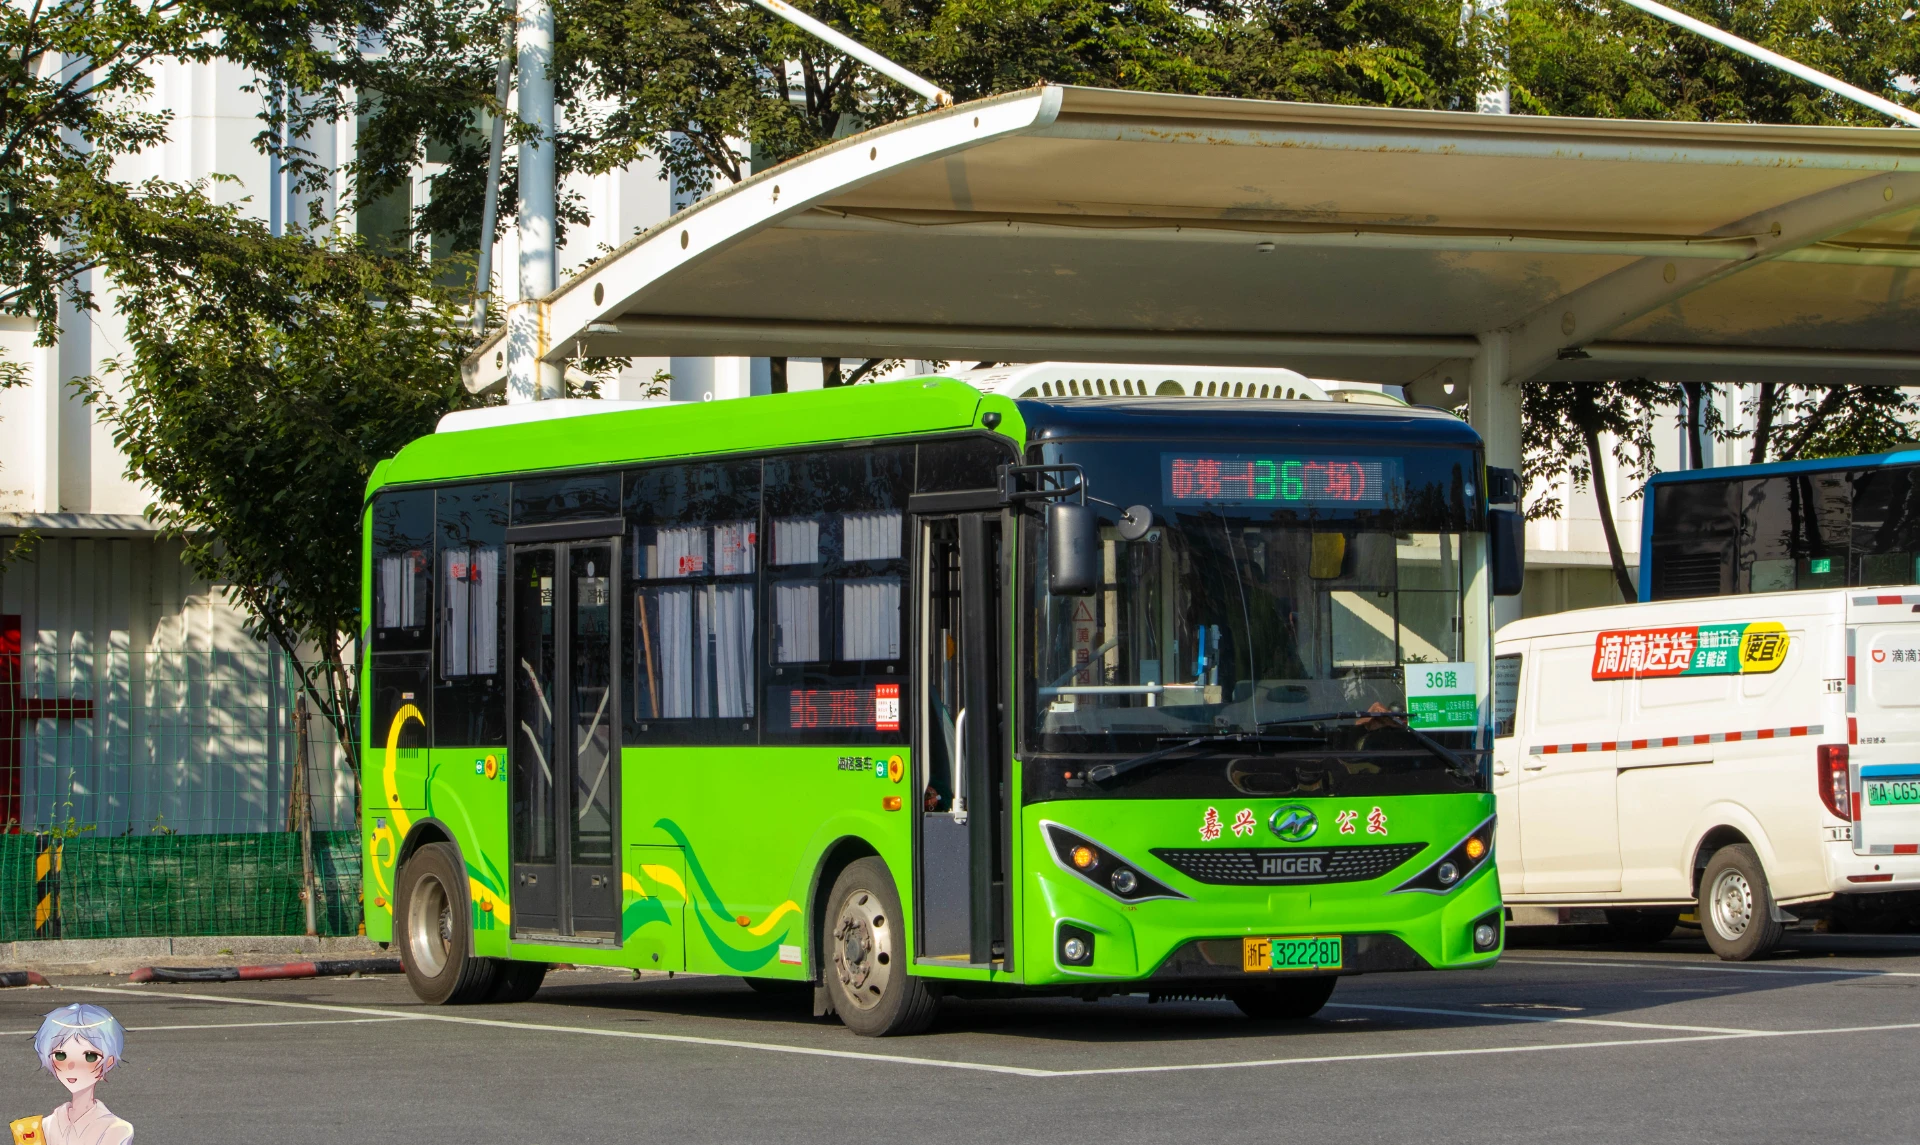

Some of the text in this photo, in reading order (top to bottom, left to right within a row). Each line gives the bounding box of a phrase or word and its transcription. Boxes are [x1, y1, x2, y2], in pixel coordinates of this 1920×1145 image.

[1699, 629, 1740, 649] 建材五金
[1597, 632, 1693, 672] 滴滴送货
[1695, 650, 1728, 668] 全能送
[1426, 671, 1457, 688] 36路
[791, 690, 818, 728] 36
[838, 756, 873, 771] 海格客车
[1199, 806, 1388, 842] 嘉兴 公交
[1262, 857, 1322, 874] HIGER
